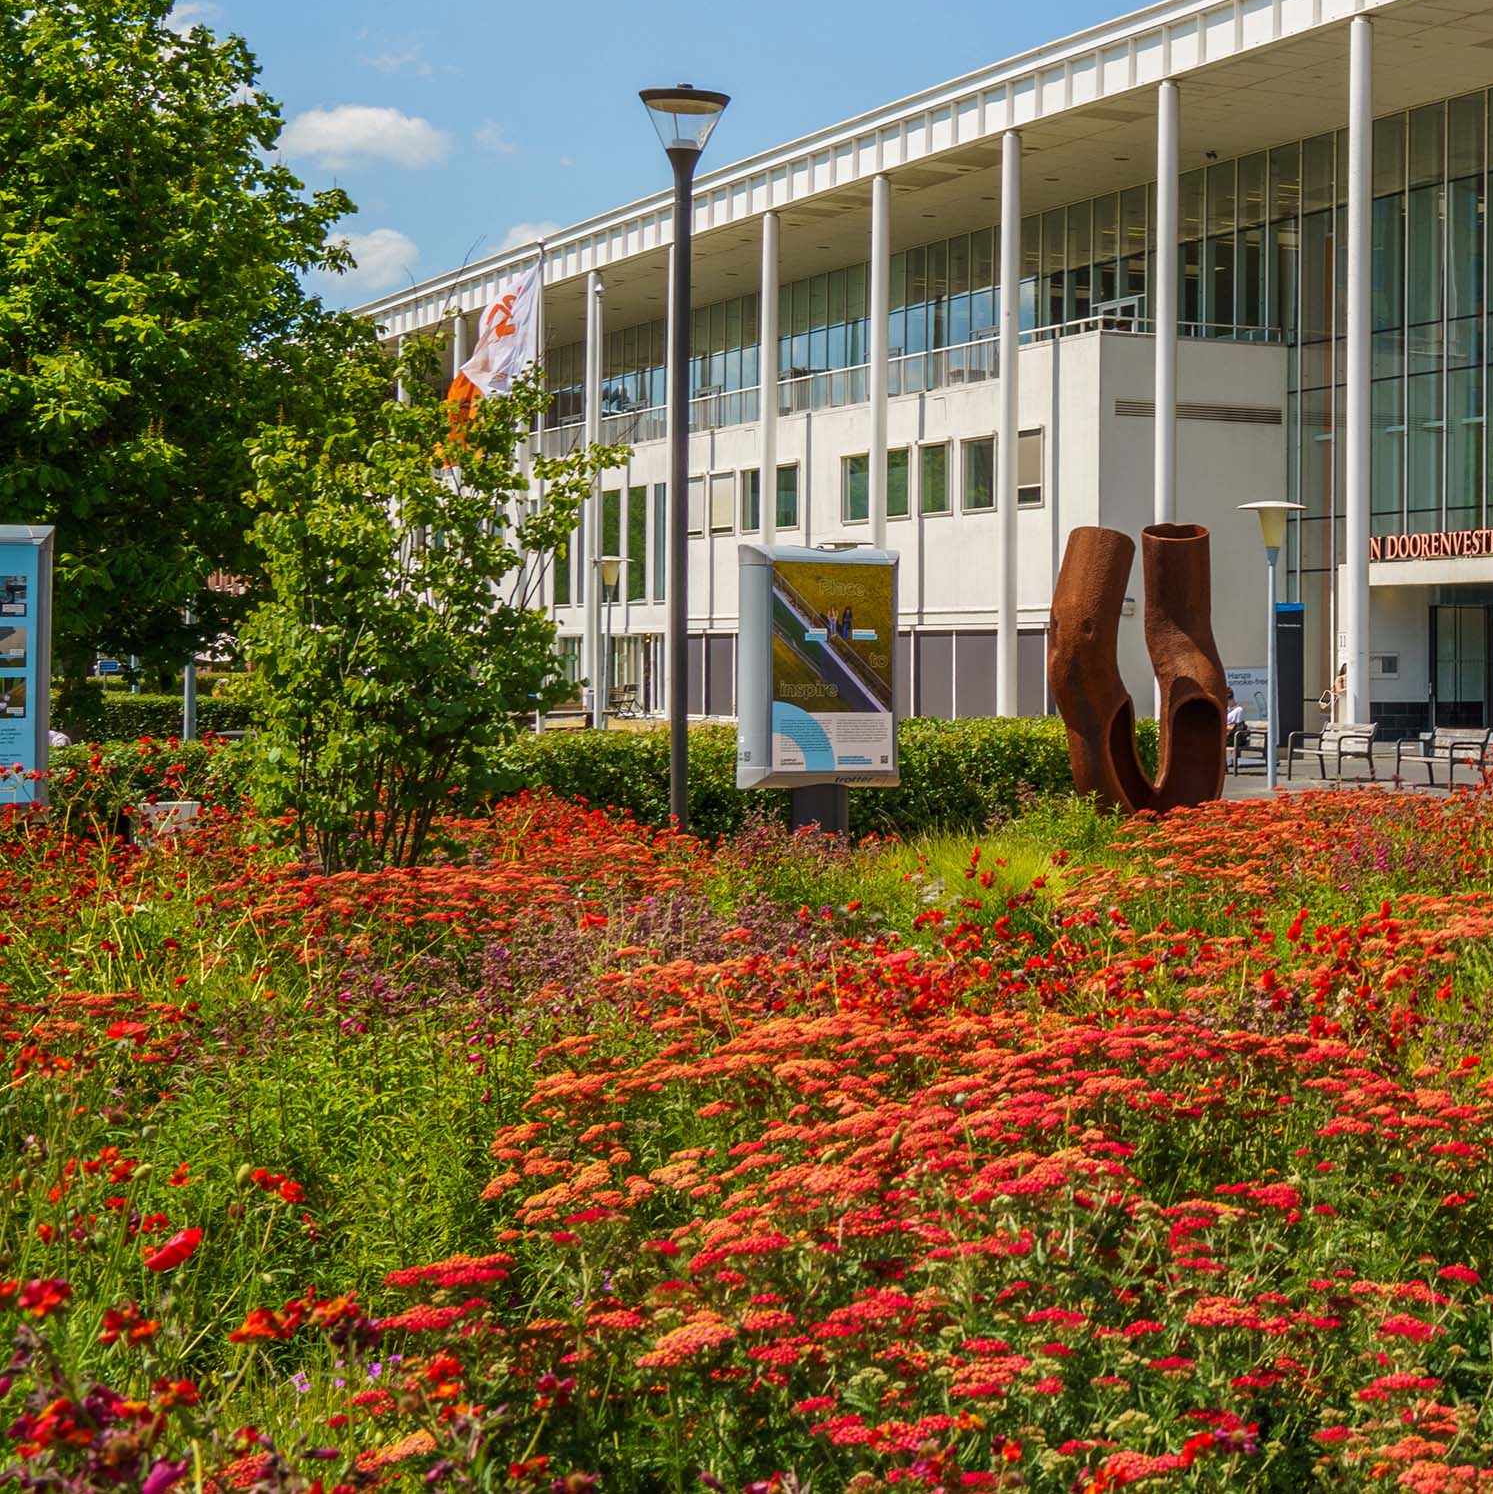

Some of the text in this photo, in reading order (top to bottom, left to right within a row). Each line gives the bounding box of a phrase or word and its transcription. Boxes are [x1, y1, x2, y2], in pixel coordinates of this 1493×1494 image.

[818, 578, 866, 596] Place
[868, 652, 889, 668] to
[779, 680, 839, 699] inspire
